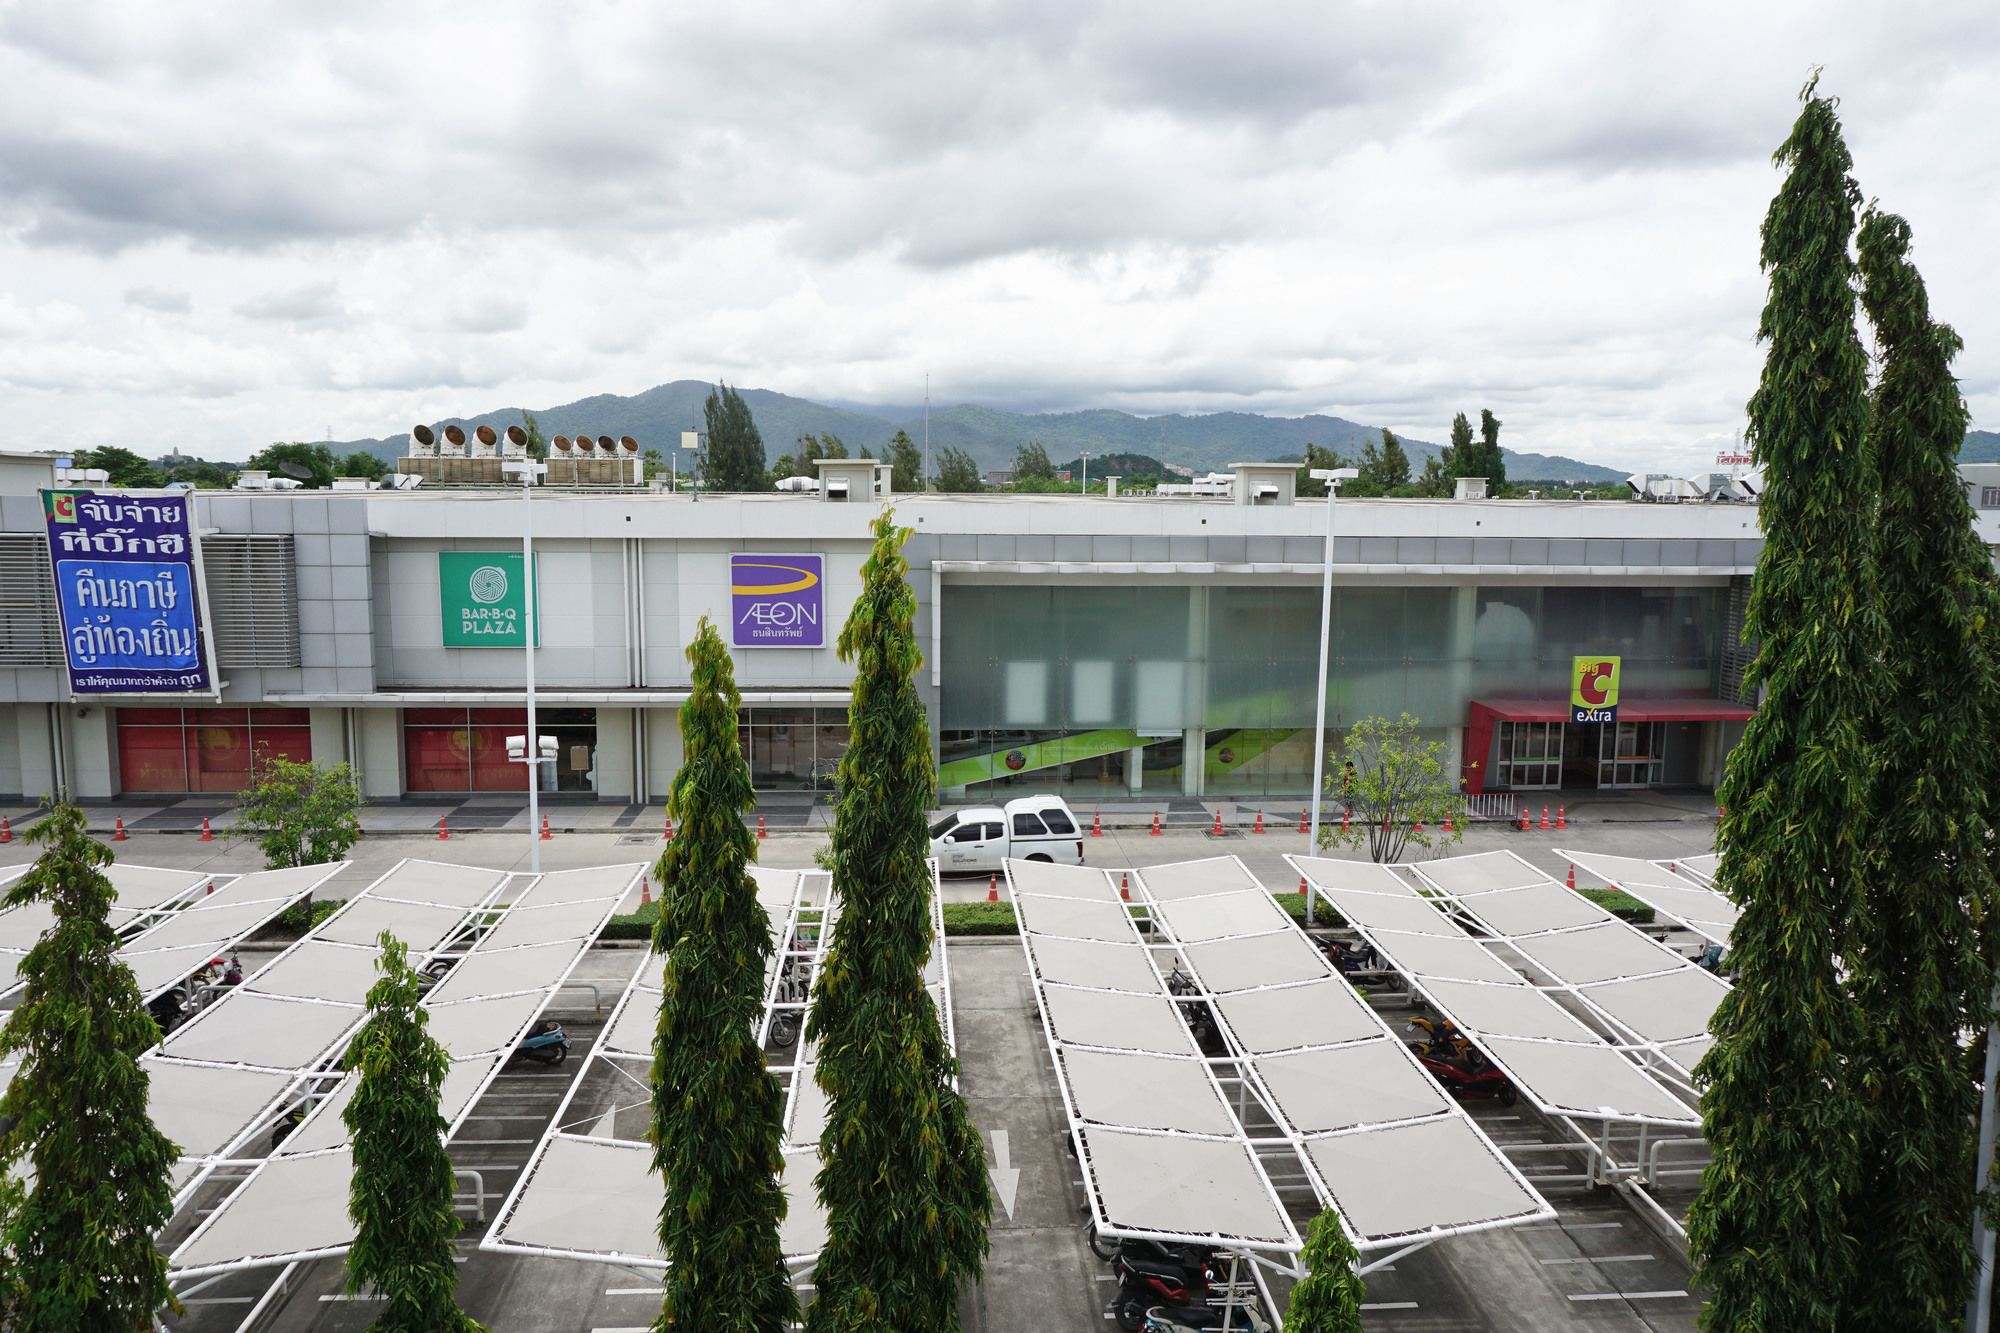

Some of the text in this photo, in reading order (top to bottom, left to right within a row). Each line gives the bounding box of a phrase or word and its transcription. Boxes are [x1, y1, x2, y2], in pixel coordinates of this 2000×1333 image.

[80, 499, 181, 523] จับจ่าย
[59, 528, 185, 554] ที่บิ๊กซี
[75, 568, 177, 608] คืนภาษี
[72, 611, 192, 663] สู่ท้องถิ่น
[462, 621, 517, 634] PLAZA
[752, 625, 804, 637] ธนสินทรัพย์
[180, 674, 202, 688] ถูก
[1579, 662, 1615, 705] Big C
